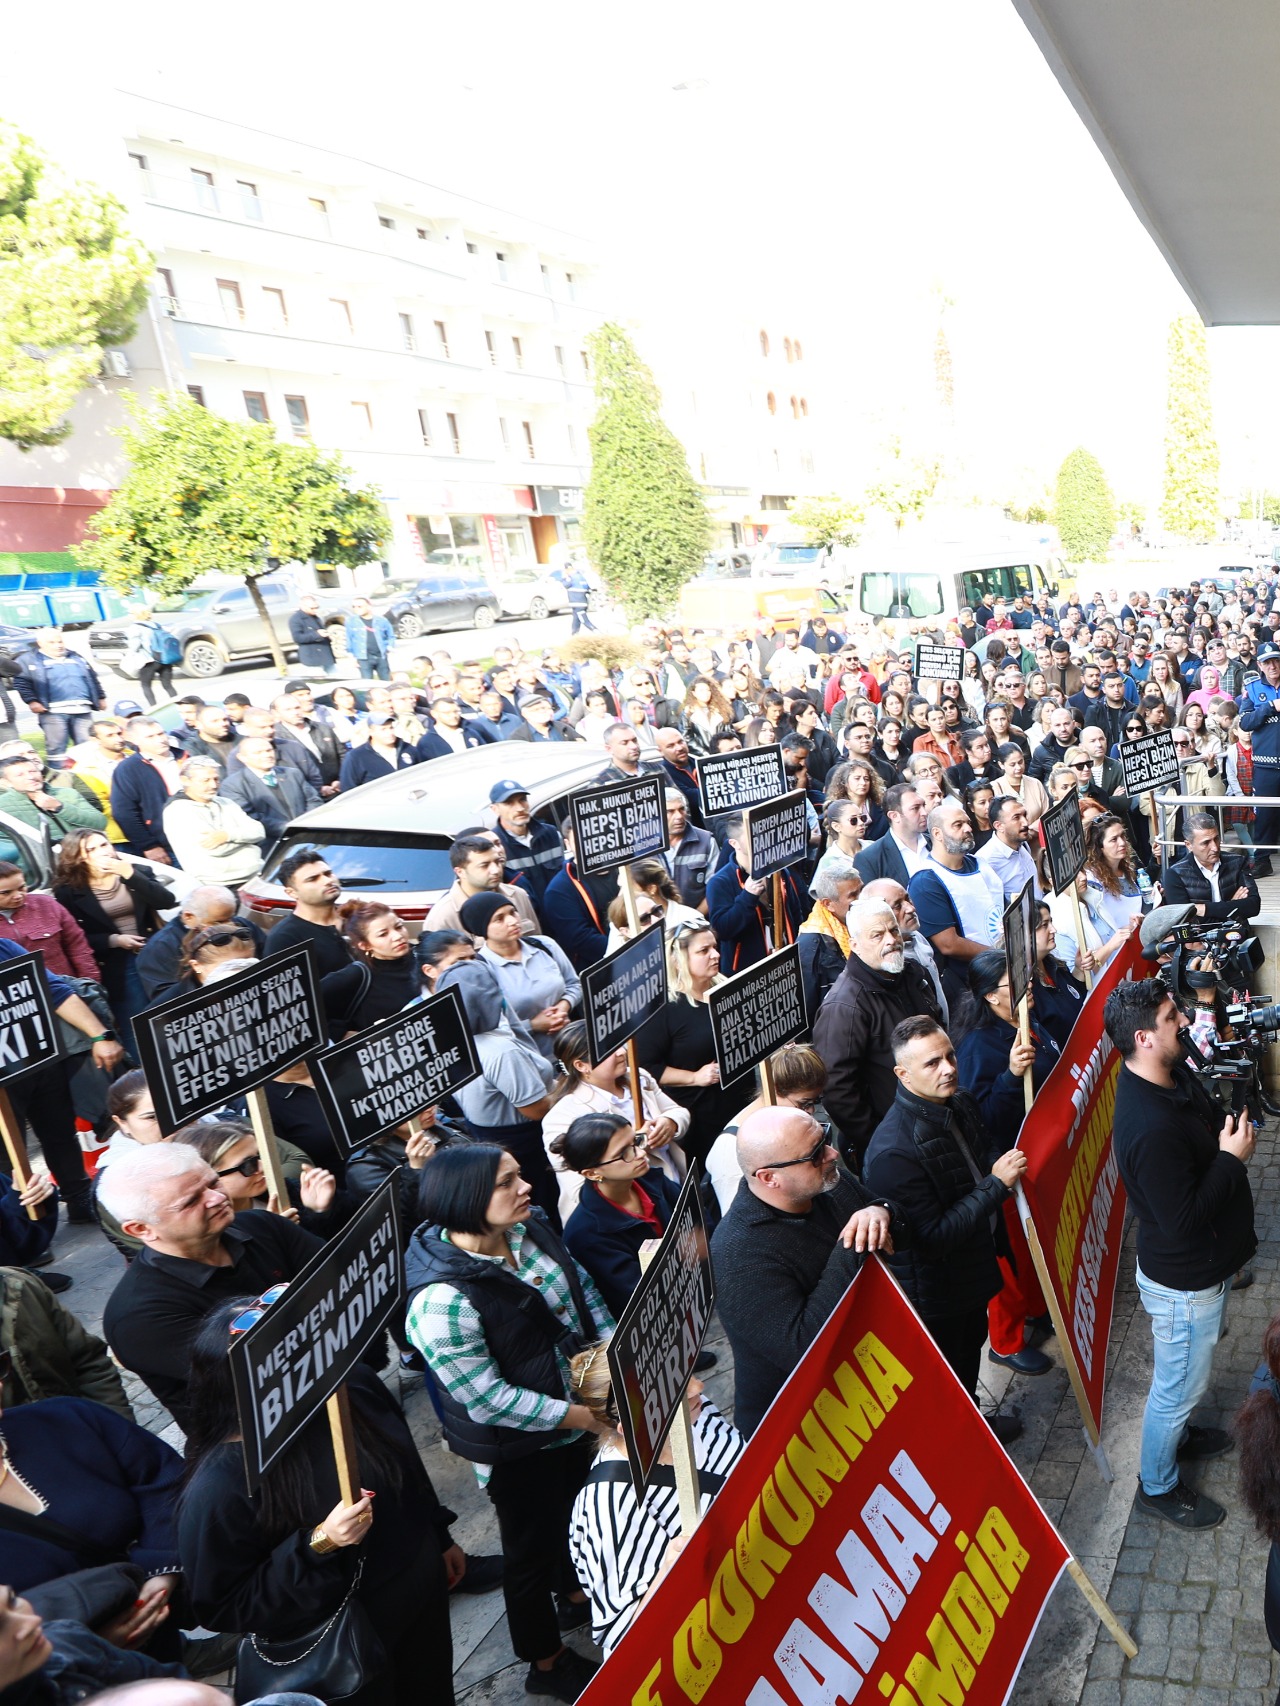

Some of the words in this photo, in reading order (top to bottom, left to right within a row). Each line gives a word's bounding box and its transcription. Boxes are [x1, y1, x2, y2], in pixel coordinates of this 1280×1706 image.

[919, 668, 959, 679] DOKUNMA!
[703, 762, 726, 774] DÜNYA
[750, 752, 778, 765] MERYEM
[1124, 750, 1149, 772] HEPSİ
[1151, 744, 1175, 763] BİZİM
[1157, 733, 1171, 745] EMEK
[634, 785, 656, 801] EMEK
[706, 771, 725, 786] ANA
[726, 768, 740, 782] EVİ
[742, 760, 780, 778] BİZİMDİR
[706, 781, 736, 798] EFES
[708, 783, 783, 811] HALKININDIR!
[1126, 766, 1149, 785] HEPSİ
[1150, 758, 1177, 778] İŞÇİNİN
[581, 807, 622, 838] HEPSİ
[625, 800, 659, 826] BİZİM
[583, 828, 620, 856] HEPSİ
[621, 818, 660, 846] İŞÇİNİN
[752, 813, 779, 835] MERYEM
[780, 808, 793, 824] ANA
[794, 800, 805, 817] EVİ
[752, 829, 776, 854] RANT
[777, 817, 805, 843] KAPISI
[754, 833, 804, 871] OLMAYACAK!
[1058, 834, 1083, 882] ADALET
[8, 975, 34, 1002] EVİ
[164, 1003, 222, 1037] SEZAR'IN
[224, 986, 260, 1012] HAKKI
[262, 965, 302, 993] SEZAR'A
[593, 971, 631, 1010] MERYEM
[631, 958, 648, 982] ANA
[648, 944, 661, 968] EVİ
[716, 991, 742, 1015] DÜNYA
[768, 958, 796, 983] MERYEM
[721, 1011, 741, 1034] ANA
[741, 994, 757, 1020] EVİ
[759, 972, 798, 1009] BİZİMDİR
[166, 1000, 262, 1060] MERYEM
[267, 978, 305, 1014] ANA
[596, 969, 663, 1043] BİZİMDİR!
[172, 1031, 253, 1085] EVİ'NİN
[256, 1000, 310, 1045] HAKKI
[177, 1065, 230, 1106] EFES
[234, 1022, 313, 1078] SELÇUK'A
[356, 1036, 396, 1067] BİZE
[394, 1015, 434, 1047] GÖRE
[361, 1030, 438, 1089] MABET
[721, 1018, 754, 1055] EFES
[724, 1005, 802, 1075] HALKININDIR!
[351, 1069, 424, 1118] İKTİDARA
[425, 1046, 461, 1078] GÖRE
[376, 1070, 451, 1126] MARKET!
[257, 1288, 334, 1390] MERYEM
[339, 1250, 369, 1302] ANA
[369, 1212, 393, 1261] EVİ
[630, 1326, 640, 1354] O
[640, 1282, 662, 1330] GÖZ
[661, 1206, 694, 1293] DİKTİĞİN
[261, 1249, 396, 1439] BİZİMDİR!
[635, 1309, 668, 1379] HALKIN
[1073, 1265, 1096, 1381] EFES
[643, 1274, 708, 1450] BIRAK!
[672, 1329, 914, 1705] DOKUNMA
